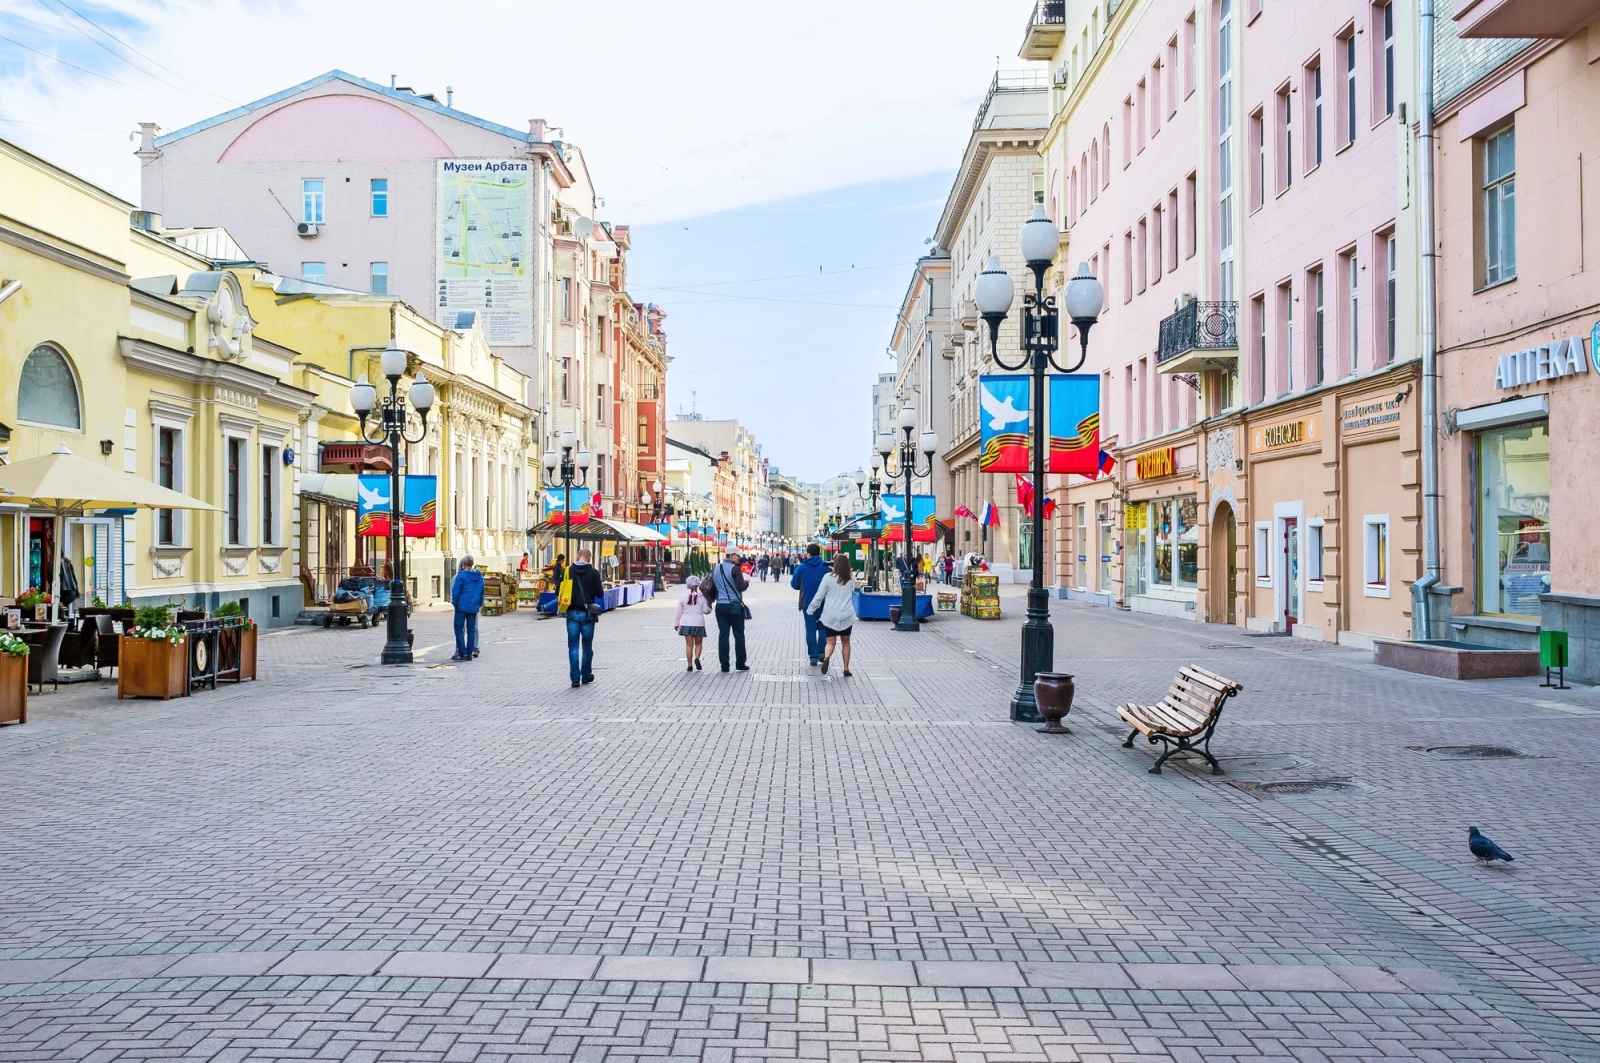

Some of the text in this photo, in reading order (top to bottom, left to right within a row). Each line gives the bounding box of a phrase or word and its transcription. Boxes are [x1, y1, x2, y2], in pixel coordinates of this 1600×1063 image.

[443, 161, 528, 173] Музеи Арбата
[1494, 335, 1588, 390] АПТЕКА
[1264, 421, 1302, 447] КОНСУЛ
[1136, 446, 1174, 480] СУВЕНИРЫ
